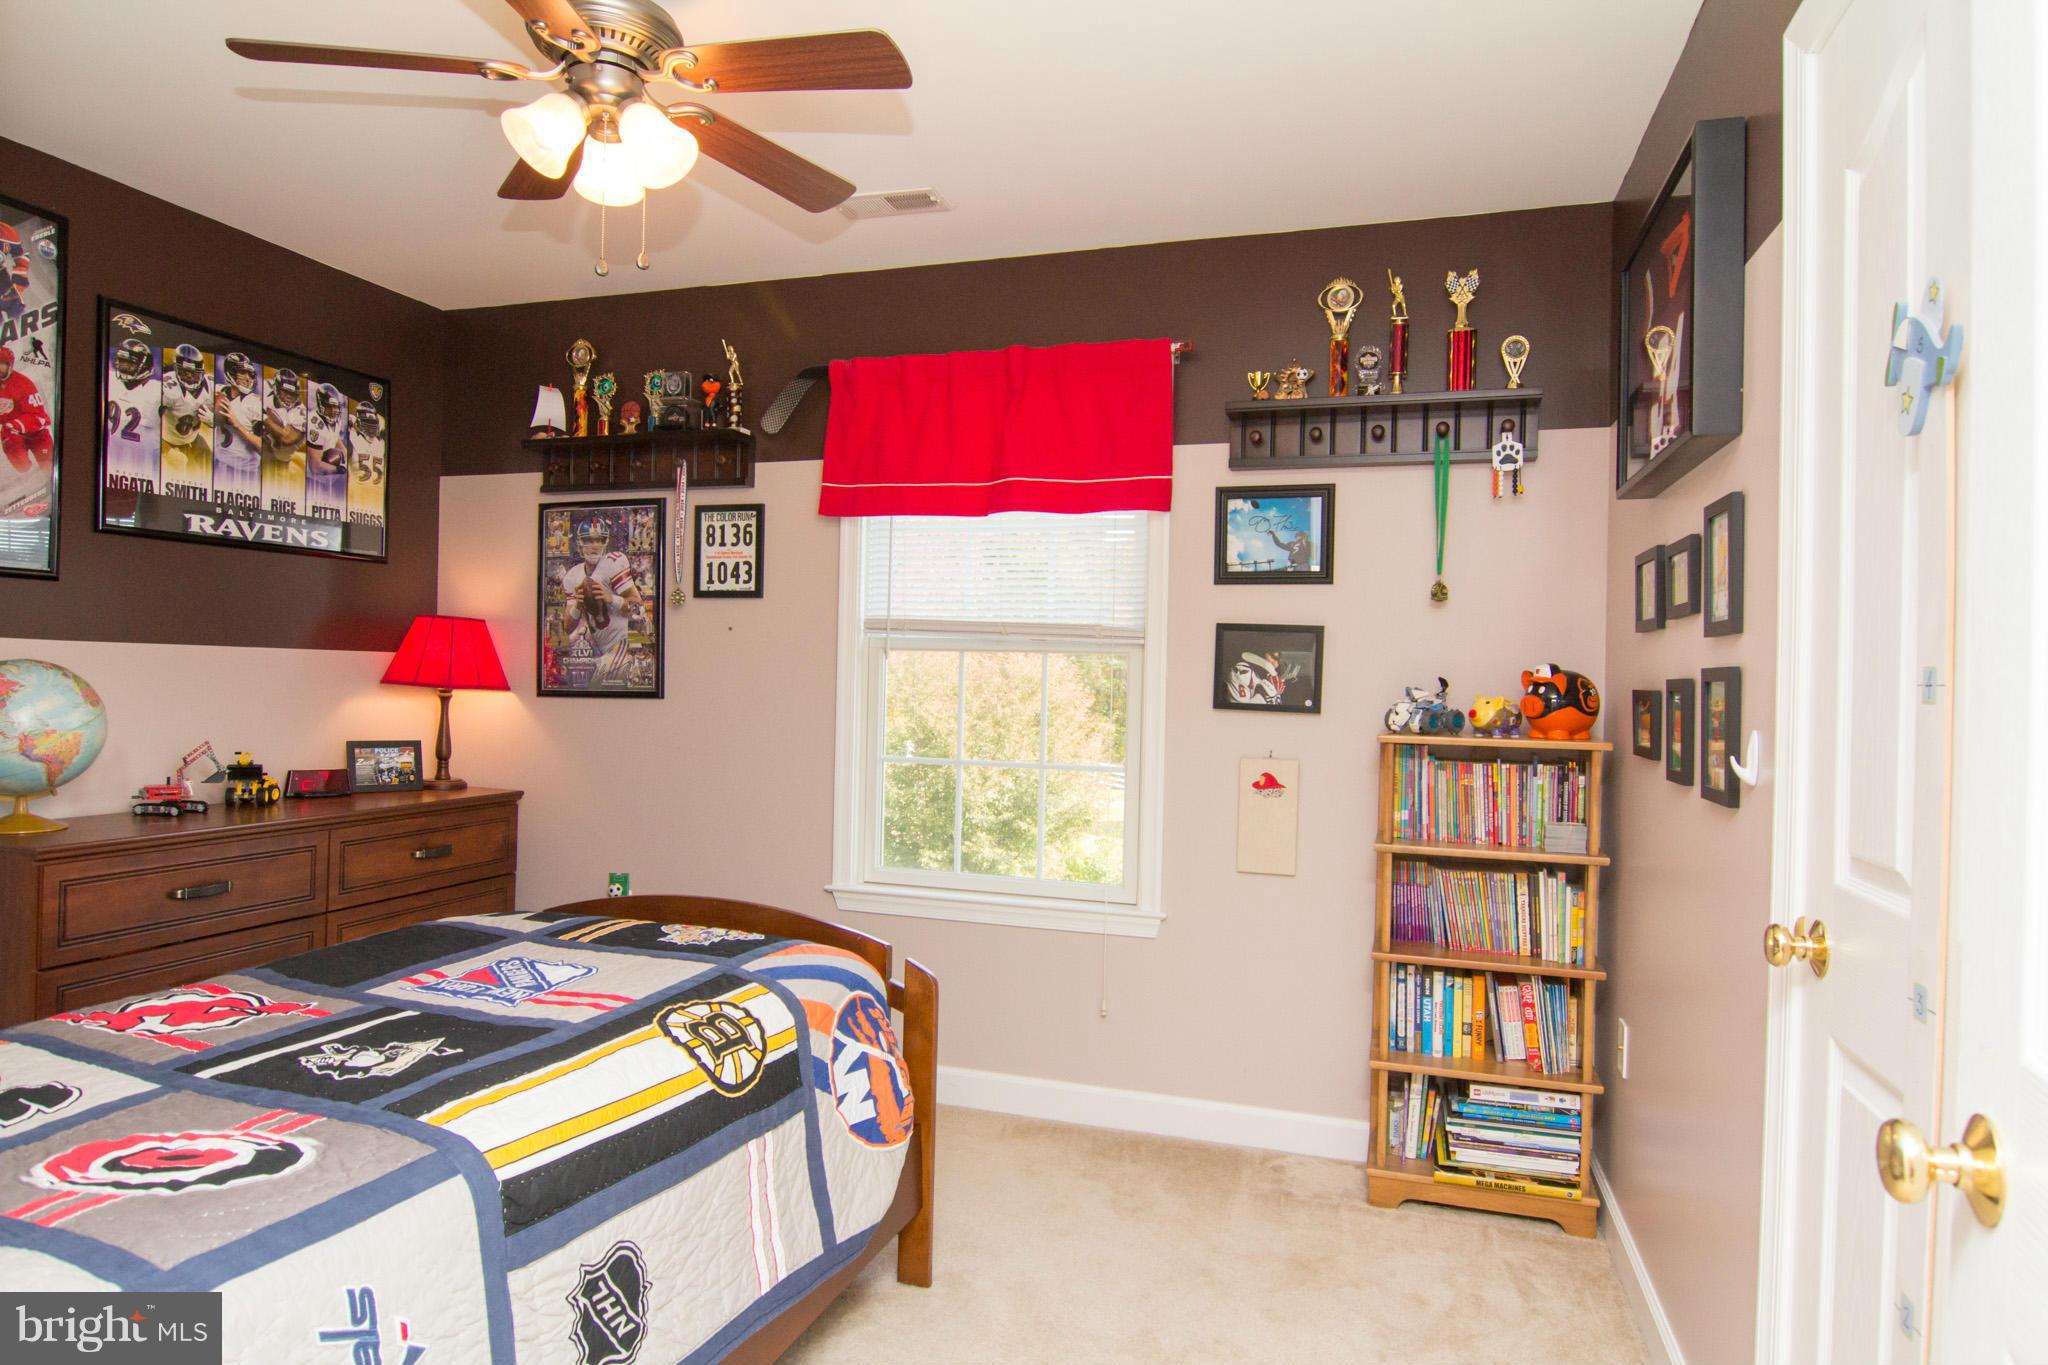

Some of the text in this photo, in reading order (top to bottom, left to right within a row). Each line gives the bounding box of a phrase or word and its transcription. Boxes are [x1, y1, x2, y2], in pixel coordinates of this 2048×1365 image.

[108, 474, 155, 495] NGATA
[165, 482, 208, 502] SMITH
[214, 489, 261, 512] FLACCO
[271, 498, 297, 516] RICE
[216, 507, 307, 525] BALTIMORE
[312, 504, 341, 521] PITTA
[349, 511, 383, 528] SUGGS
[704, 513, 715, 522] THE
[716, 512, 737, 522] COLOR
[184, 513, 329, 547] RAVENS
[705, 523, 754, 548] 8136
[706, 560, 753, 585] 1043
[1522, 984, 1534, 1004] CAMP
[1423, 998, 1432, 1023] UTAH
[685, 1011, 755, 1065] B
[1475, 1024, 1484, 1046] FUNNY
[1475, 1179, 1526, 1193] MEGA MACHINES
[591, 1280, 637, 1339] NHL
